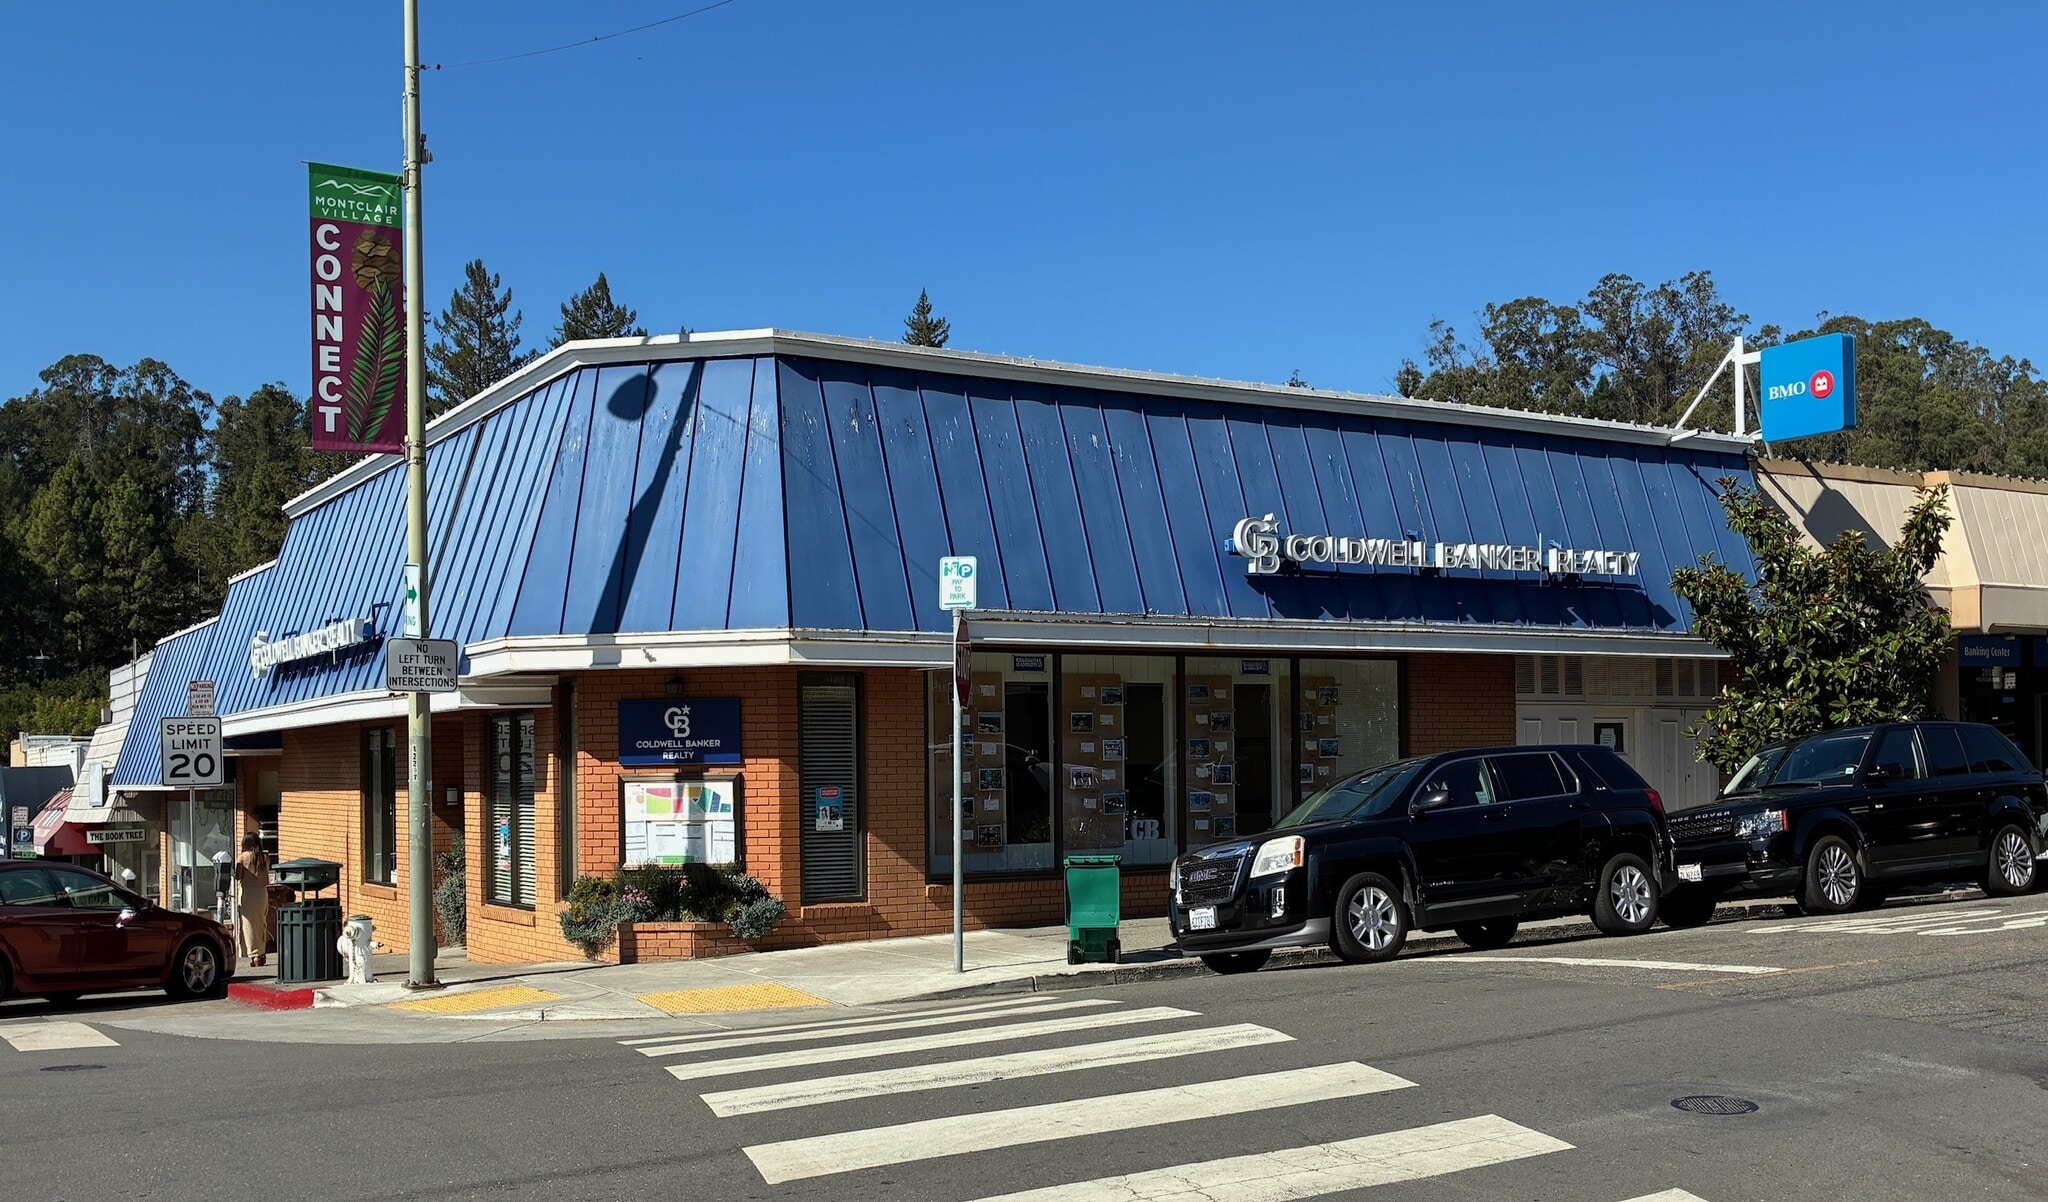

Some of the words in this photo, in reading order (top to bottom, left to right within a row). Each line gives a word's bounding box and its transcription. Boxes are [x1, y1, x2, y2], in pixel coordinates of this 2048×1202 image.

[316, 196, 397, 215] MONTCLAIR
[322, 208, 392, 224] VILLAGE
[315, 223, 343, 433] CONNECT
[1769, 381, 1806, 400] BMO
[1286, 534, 1434, 568] COLDWELL
[1435, 542, 1541, 572] BANKER
[1548, 548, 1641, 576] REALTY
[416, 644, 428, 654] NO
[1964, 646, 1990, 659] Banking
[1991, 647, 2010, 657] Center
[399, 654, 420, 664] LEFT
[423, 655, 446, 665] TURN
[402, 666, 443, 676] BETWEEN
[389, 677, 456, 687] INTERSECTIONS
[167, 724, 217, 735] SPEED
[172, 738, 211, 750] LIMIT
[636, 740, 683, 748] COLDWELL
[685, 739, 721, 748] BANKER
[663, 751, 695, 760] REALTY
[169, 753, 215, 778] 20
[1695, 810, 1731, 820] ROVER
[1131, 819, 1160, 840] CB
[90, 832, 103, 841] THE
[105, 832, 123, 840] BOOK
[125, 831, 143, 840] TREE
